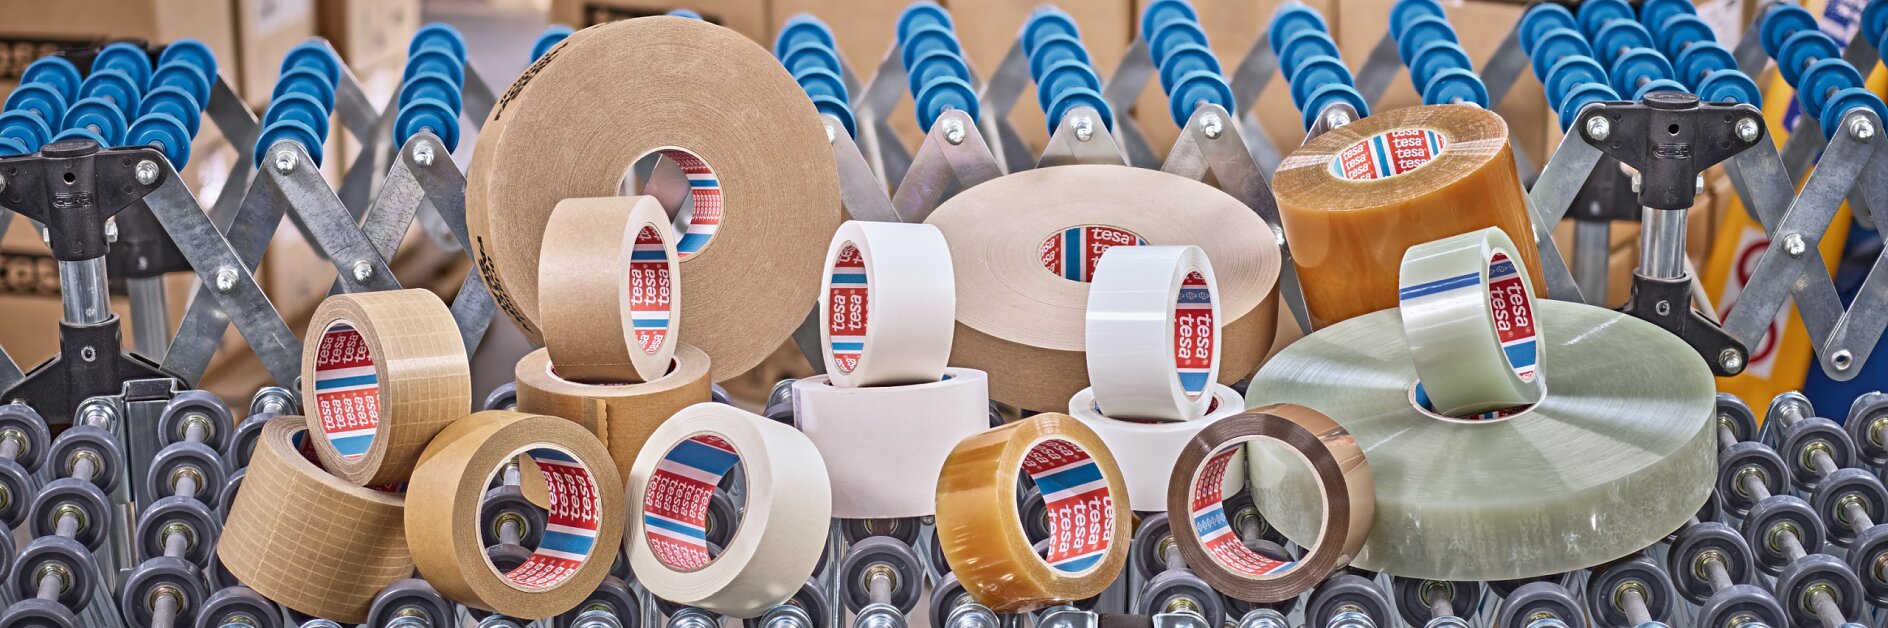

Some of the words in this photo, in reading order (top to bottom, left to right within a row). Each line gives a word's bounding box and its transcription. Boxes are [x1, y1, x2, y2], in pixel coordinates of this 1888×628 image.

[1343, 144, 1364, 161] tesa
[1392, 138, 1422, 148] tesa
[1395, 148, 1425, 159] tesa
[1345, 153, 1366, 170] tesa
[1091, 228, 1130, 245] tesa
[1091, 242, 1110, 254] te
[631, 269, 643, 306] tesa
[644, 269, 656, 306] tesa
[658, 268, 670, 306] tesa
[832, 295, 846, 332] tesa
[848, 294, 862, 331] tesa
[1491, 286, 1511, 331] tesa
[1506, 282, 1529, 327] tesa
[317, 337, 334, 366] tesa
[329, 335, 346, 365] tesa
[342, 334, 359, 364] tesa
[1179, 313, 1195, 359] tesa
[1196, 313, 1212, 359] tesa
[321, 400, 336, 430] tesa
[332, 399, 346, 429] tesa
[343, 397, 358, 428] tesa
[354, 396, 369, 427] tesa
[365, 395, 379, 425] tesa
[552, 471, 569, 519] tesa
[564, 473, 580, 521] tesa
[575, 475, 592, 523] tesa
[646, 474, 661, 506] tesa
[655, 477, 670, 509] tesa
[663, 479, 679, 511] tesa
[671, 482, 687, 514] tesa
[681, 484, 695, 516] tesa
[689, 487, 704, 519] tesa
[698, 490, 712, 521] tesa
[1059, 504, 1072, 553] tesa
[1073, 500, 1087, 549] tesa
[1088, 496, 1101, 545] tesa
